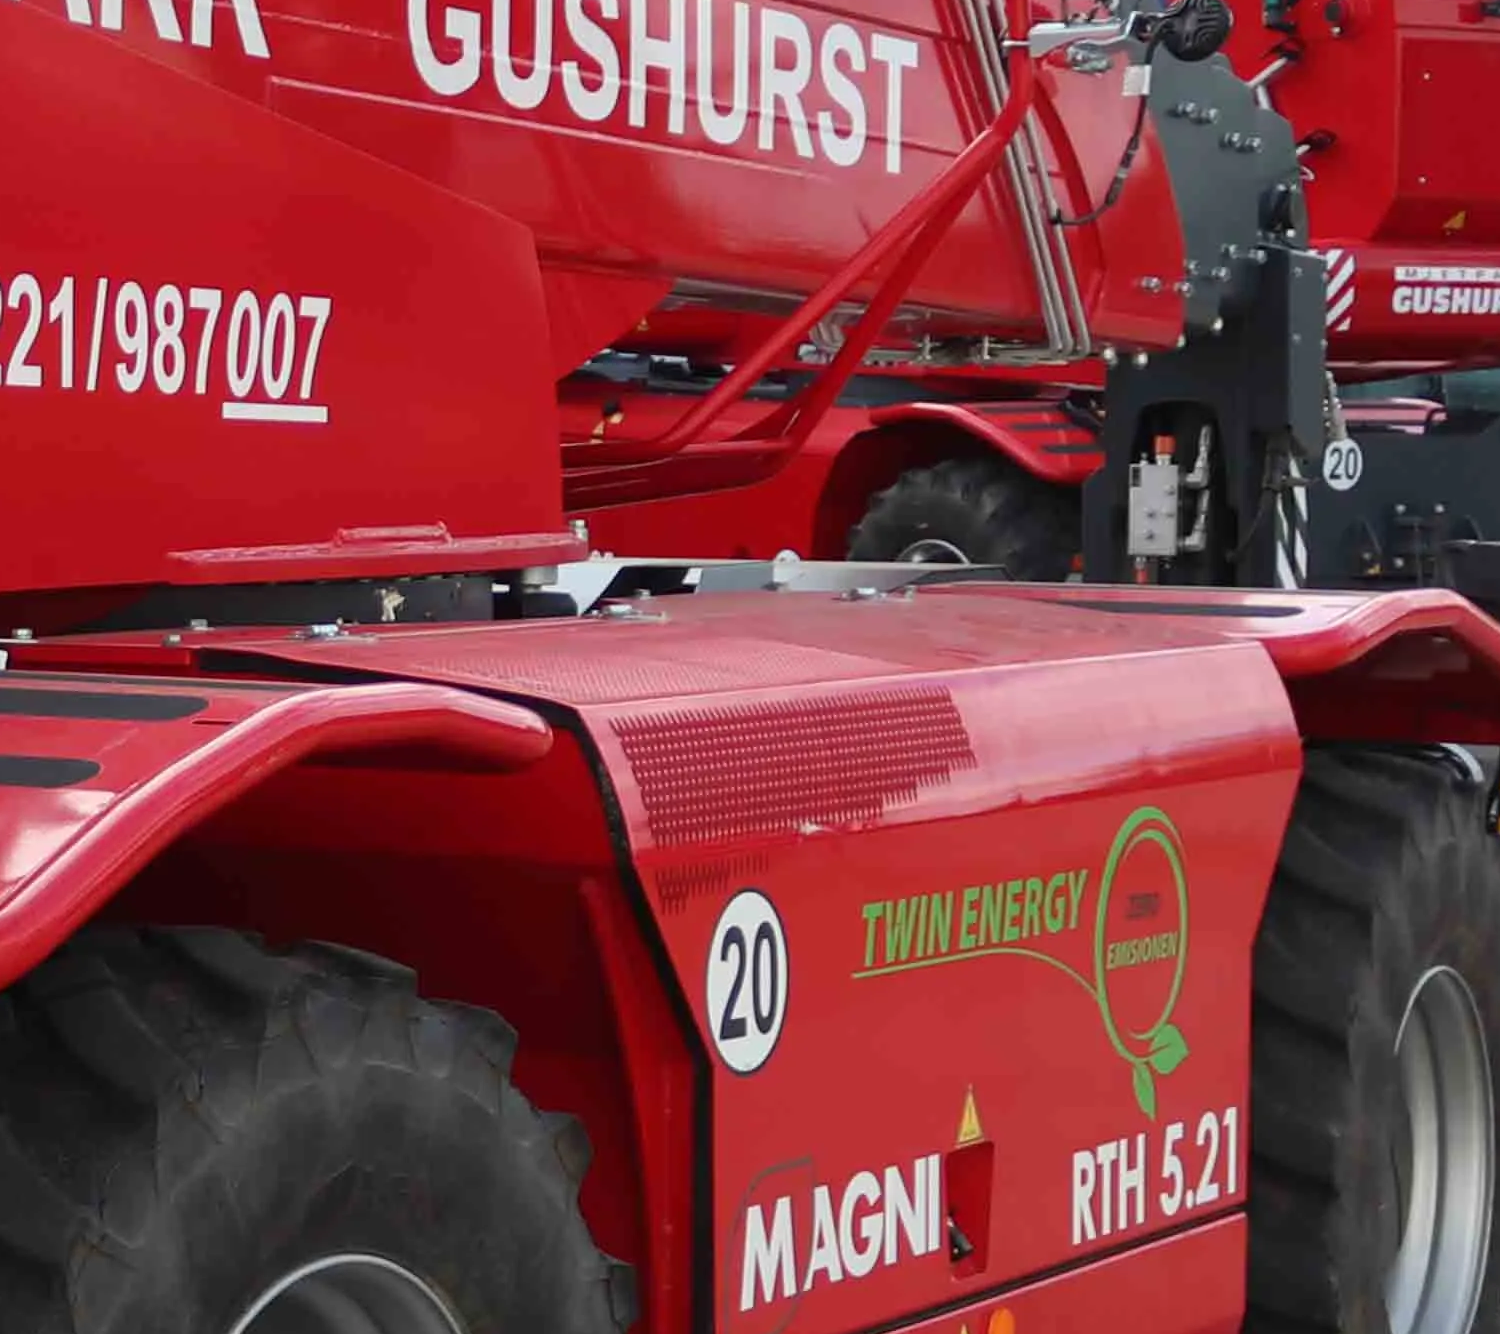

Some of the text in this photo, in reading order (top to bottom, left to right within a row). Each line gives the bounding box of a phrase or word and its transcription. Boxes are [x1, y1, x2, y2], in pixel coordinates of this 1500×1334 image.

[1330, 448, 1357, 480] 20
[863, 869, 1088, 967] TWIN ENERGY
[719, 926, 779, 1041] 20
[740, 1154, 941, 1312] MAGNI
[1072, 1106, 1238, 1245] RTH 5.21
